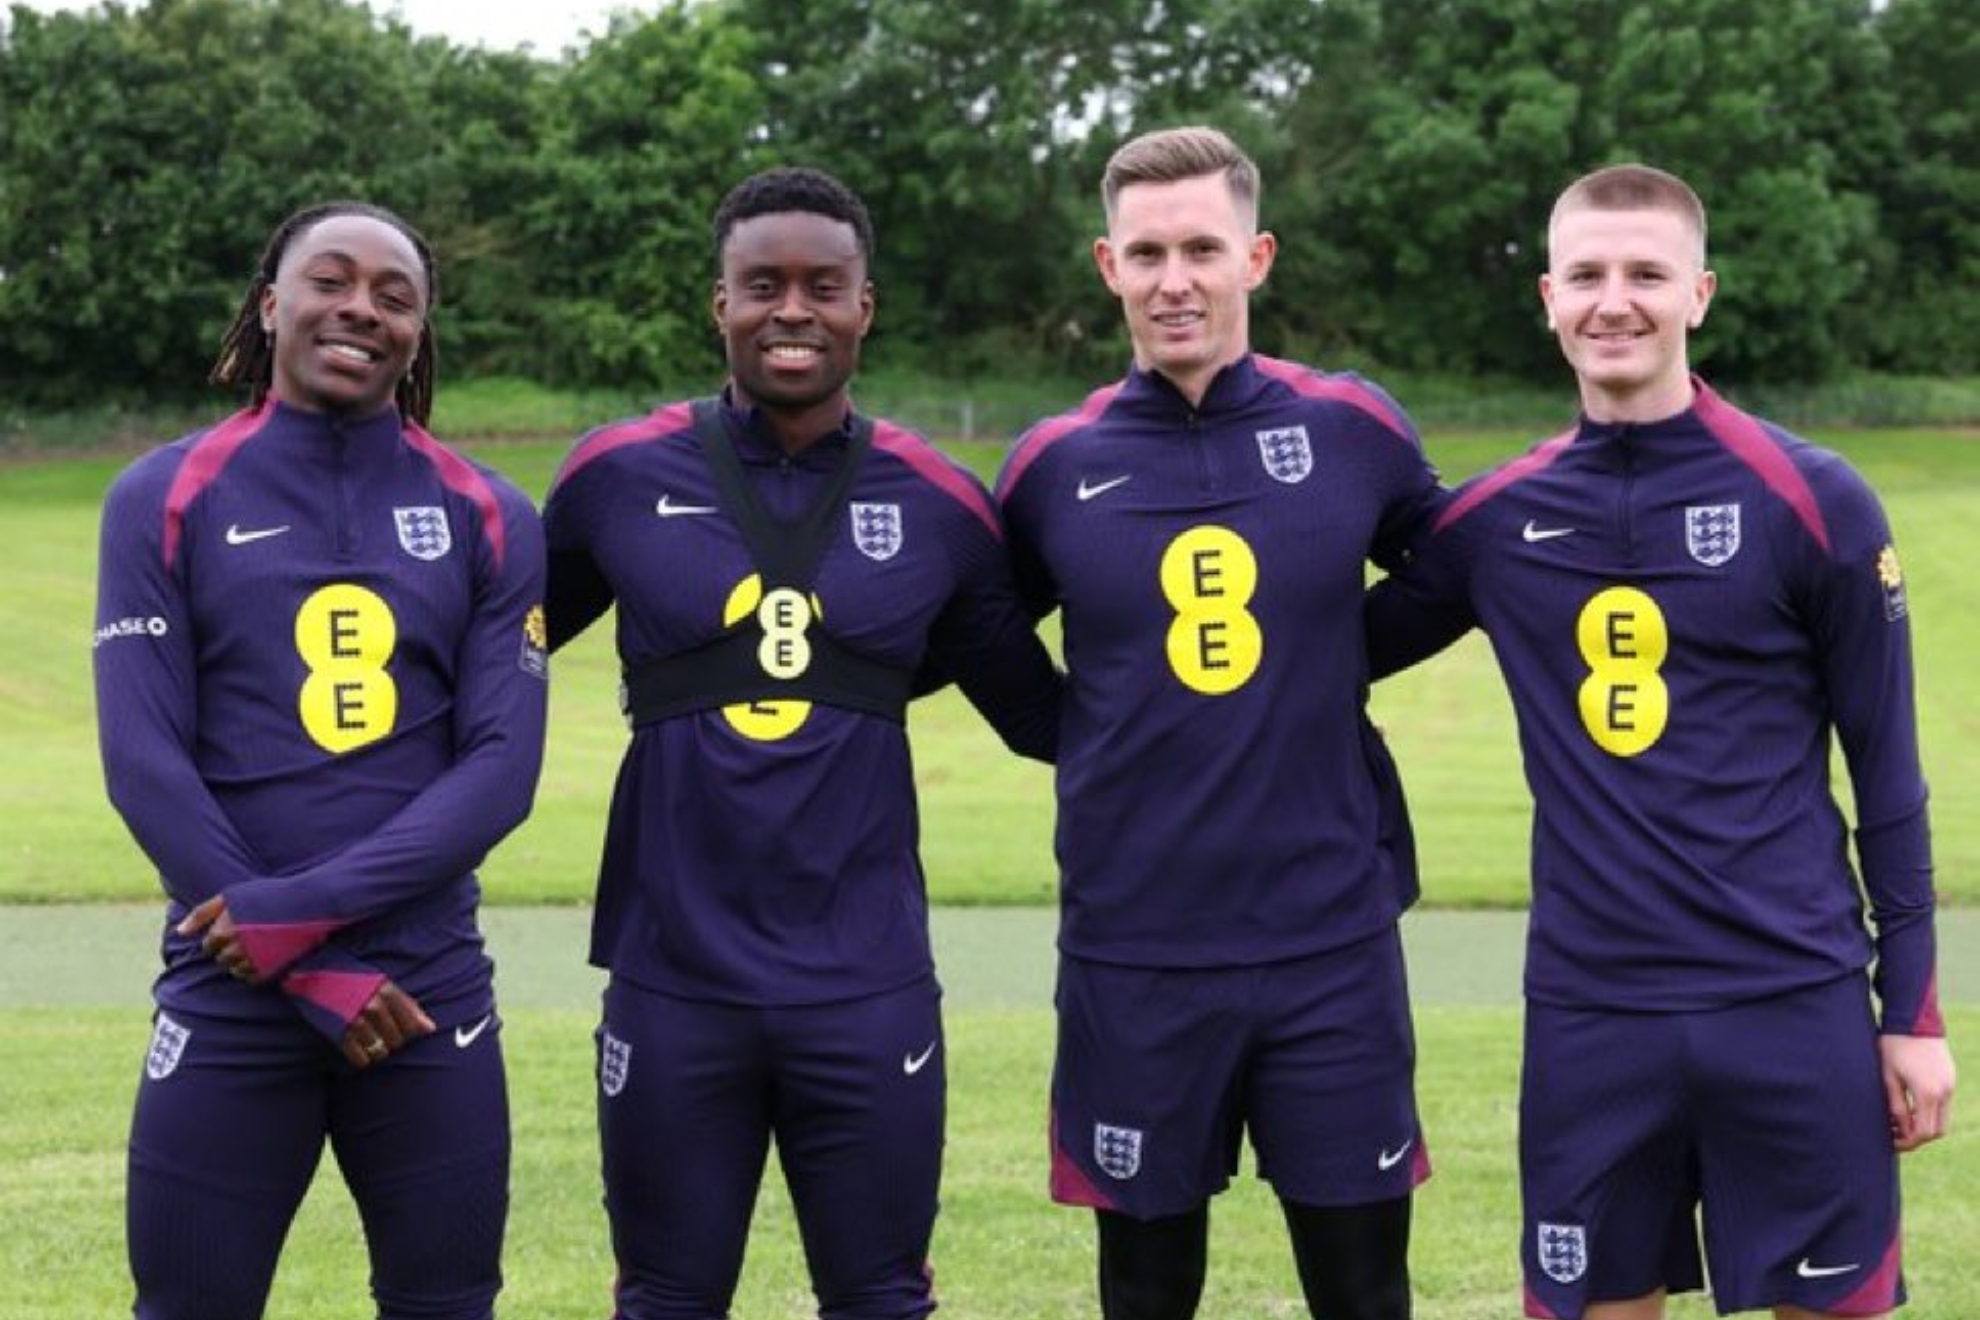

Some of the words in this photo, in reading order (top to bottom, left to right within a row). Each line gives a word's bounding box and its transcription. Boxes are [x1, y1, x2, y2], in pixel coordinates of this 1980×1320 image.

[1193, 550, 1223, 597] E
[330, 610, 361, 658] E
[775, 600, 794, 628] E
[1607, 612, 1637, 658] E
[775, 639, 794, 667] E
[1199, 622, 1230, 669] E
[334, 683, 366, 729] E
[1608, 684, 1636, 731] E
